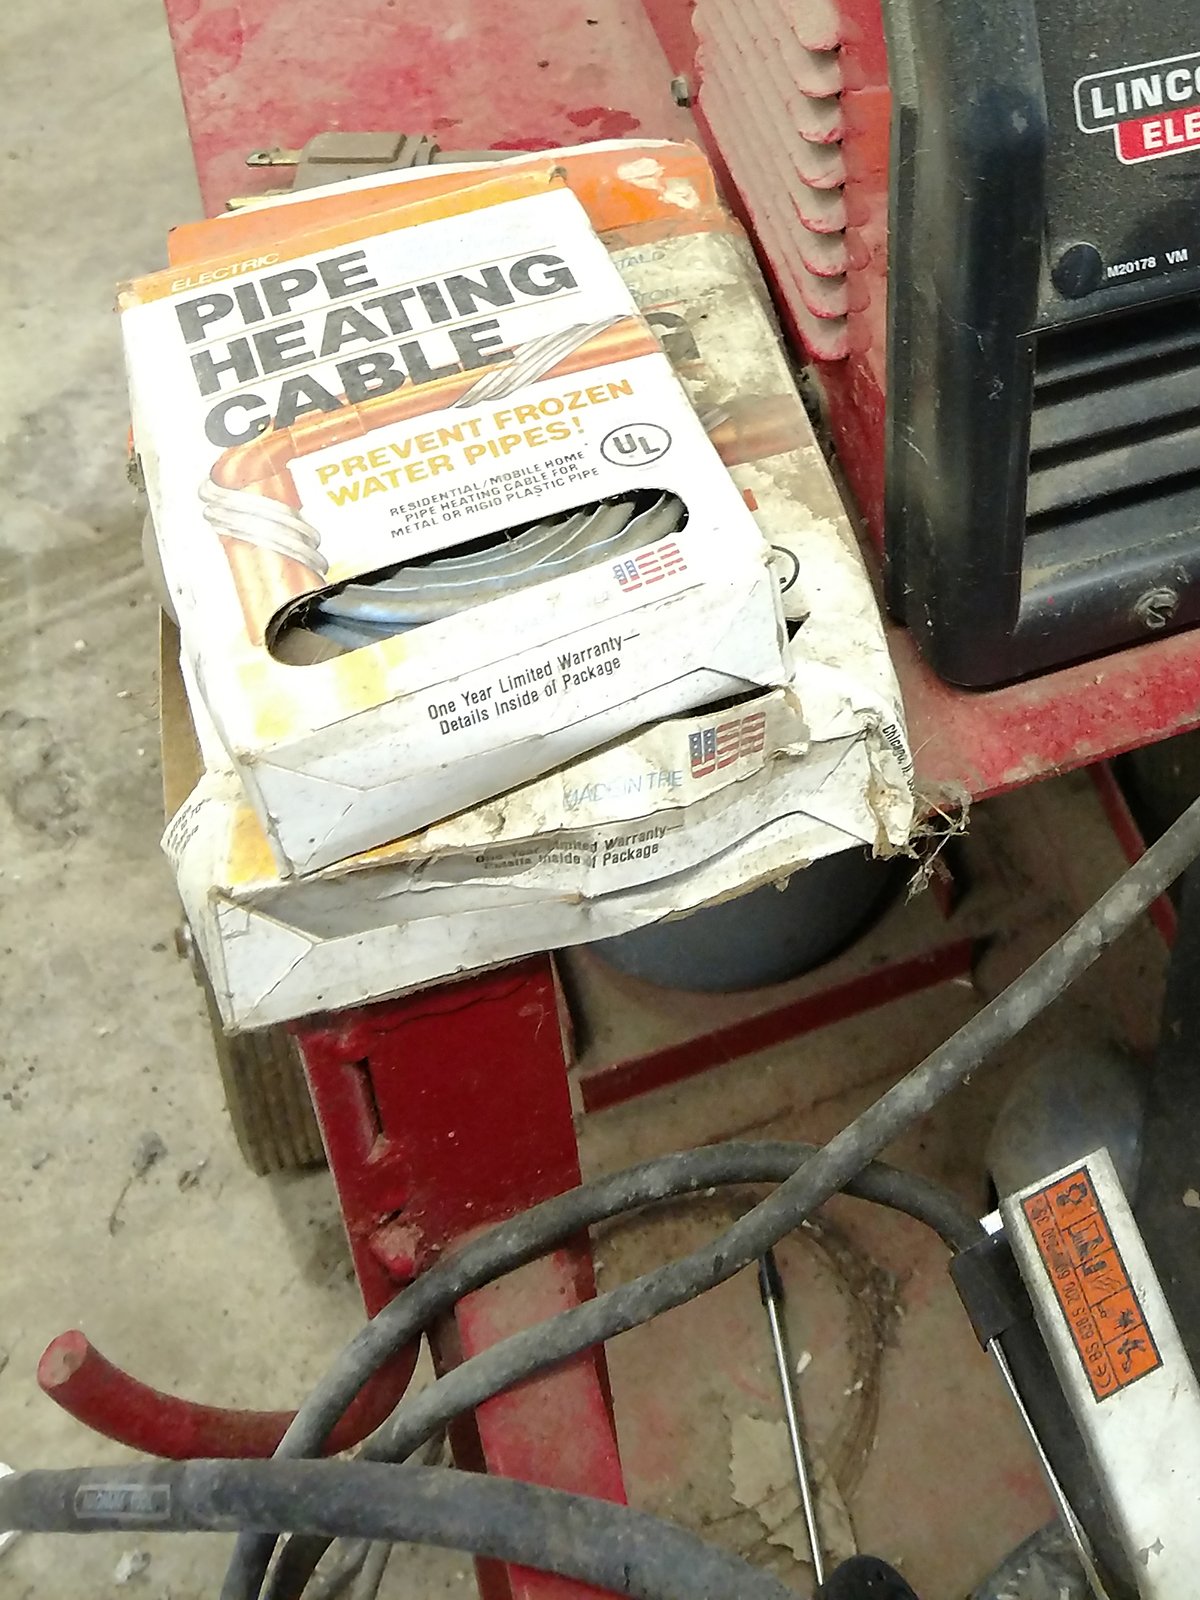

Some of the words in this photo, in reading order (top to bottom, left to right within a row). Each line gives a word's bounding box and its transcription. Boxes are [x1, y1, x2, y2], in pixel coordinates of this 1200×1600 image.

[171, 253, 279, 293] ELECTRIC
[174, 250, 379, 345] PIPE
[1106, 256, 1157, 279] M20178
[1165, 249, 1189, 265] VM
[190, 254, 578, 397] HEATING
[204, 319, 515, 449] CABLE
[315, 417, 482, 486] PREVENT
[493, 378, 635, 431] FROZEN
[326, 455, 454, 507] WATER
[462, 416, 585, 467] PIPES!
[389, 463, 541, 517] RESIDENTIAL/MOBILE
[545, 450, 585, 470] HOME
[390, 517, 439, 539] METAL
[442, 508, 463, 522] OR
[465, 498, 503, 515] RIGID
[506, 479, 566, 501] PLASTIC
[569, 467, 600, 483] PIPE
[405, 506, 437, 523] PIPE
[440, 487, 501, 511] HEATING
[503, 475, 548, 492] CABLE
[552, 463, 579, 478] FOR
[427, 700, 457, 720] One
[460, 685, 493, 708] Year
[498, 661, 553, 694] Limited
[439, 710, 490, 735] Details
[495, 690, 539, 716] Inside
[544, 679, 558, 697] of
[563, 656, 622, 692] Package
[646, 770, 683, 789] THE
[602, 843, 660, 867] Package
